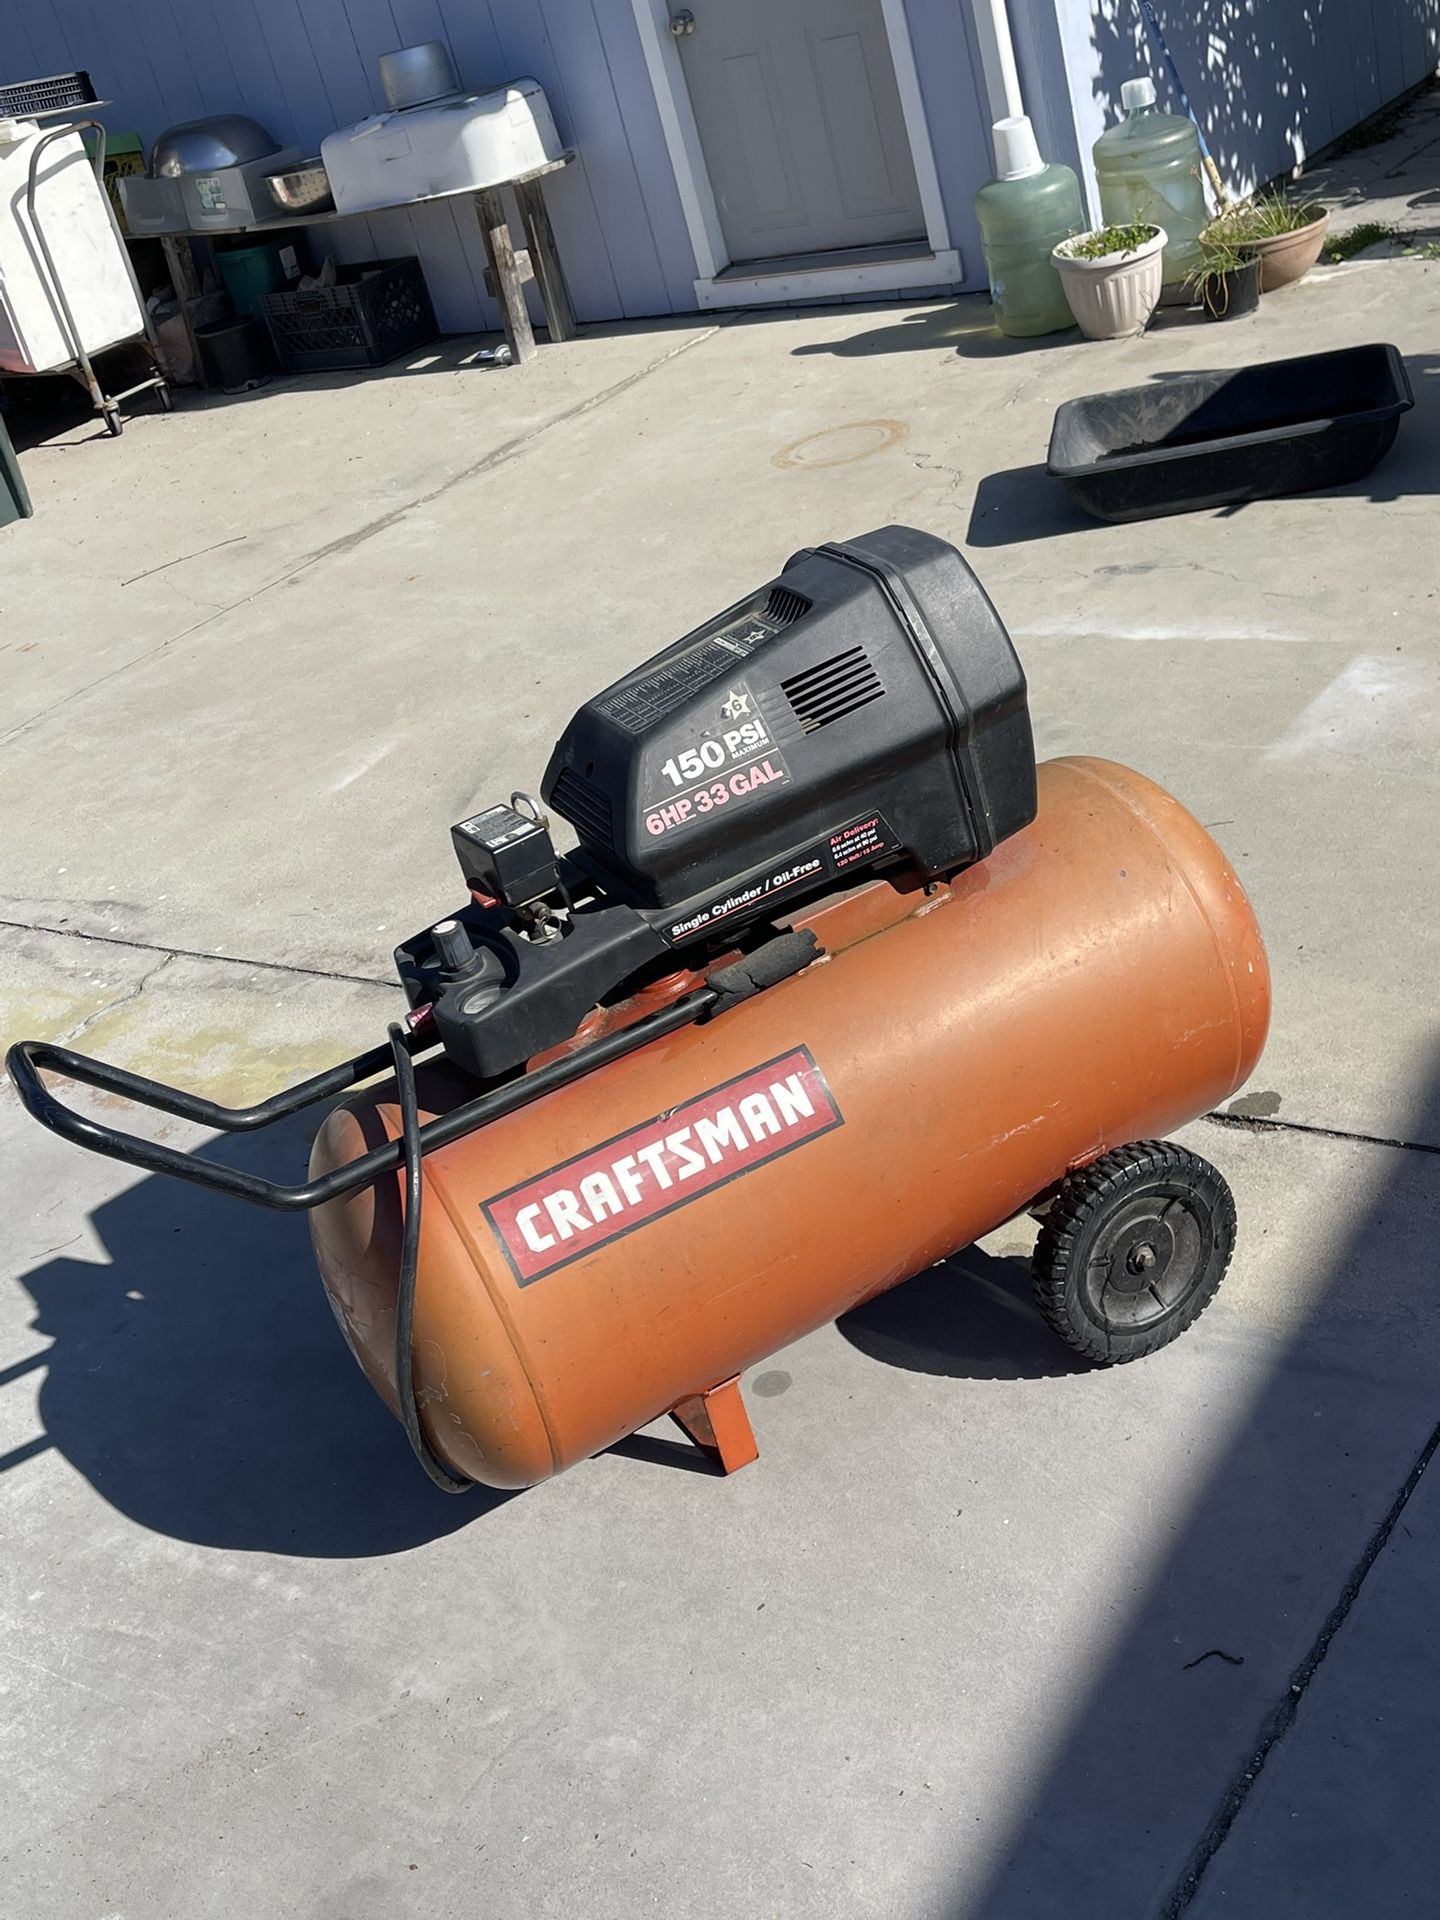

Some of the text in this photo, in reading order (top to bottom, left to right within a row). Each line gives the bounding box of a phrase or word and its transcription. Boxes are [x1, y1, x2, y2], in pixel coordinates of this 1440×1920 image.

[732, 699, 743, 712] 6
[661, 719, 767, 787] 150 PSI
[731, 737, 770, 760] MAXIMUM
[646, 798, 692, 836] 6HP
[694, 783, 730, 813] 33
[729, 760, 784, 796] GAL
[830, 818, 879, 846] Air Delivery:
[671, 858, 820, 936] Single Cylinder / Oil-Free
[515, 1072, 816, 1253] CRAFTSMAN
